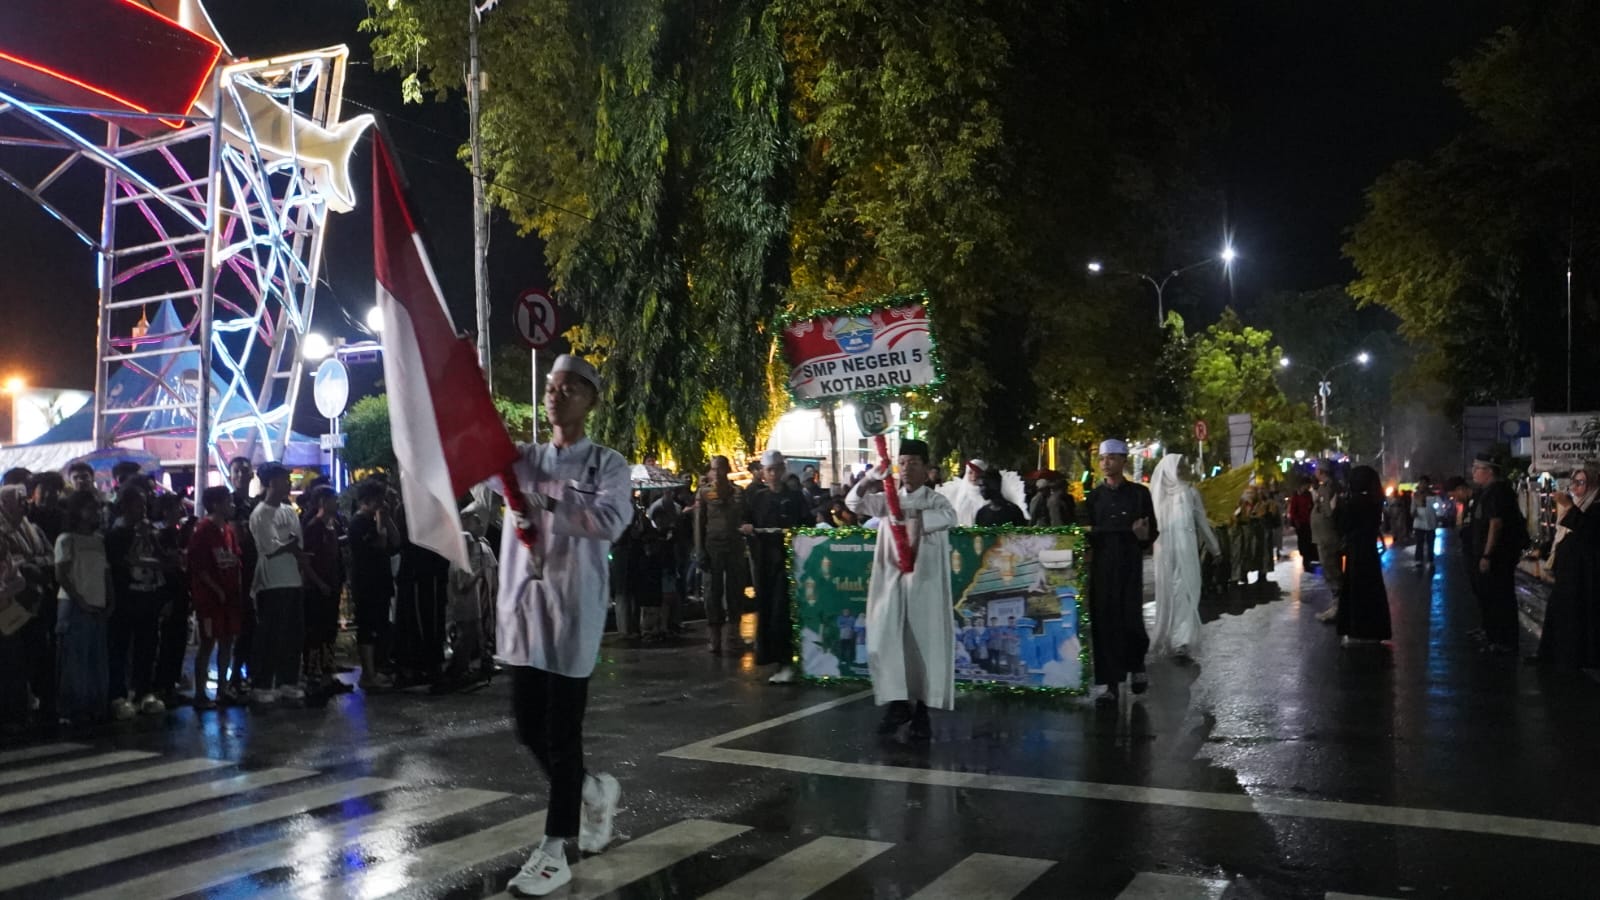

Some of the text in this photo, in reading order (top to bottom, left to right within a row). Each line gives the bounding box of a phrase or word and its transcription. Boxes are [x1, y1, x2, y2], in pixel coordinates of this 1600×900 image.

[803, 348, 922, 378] SMP NEGERI 5
[821, 369, 912, 394] KOTABARU
[864, 410, 884, 426] 05
